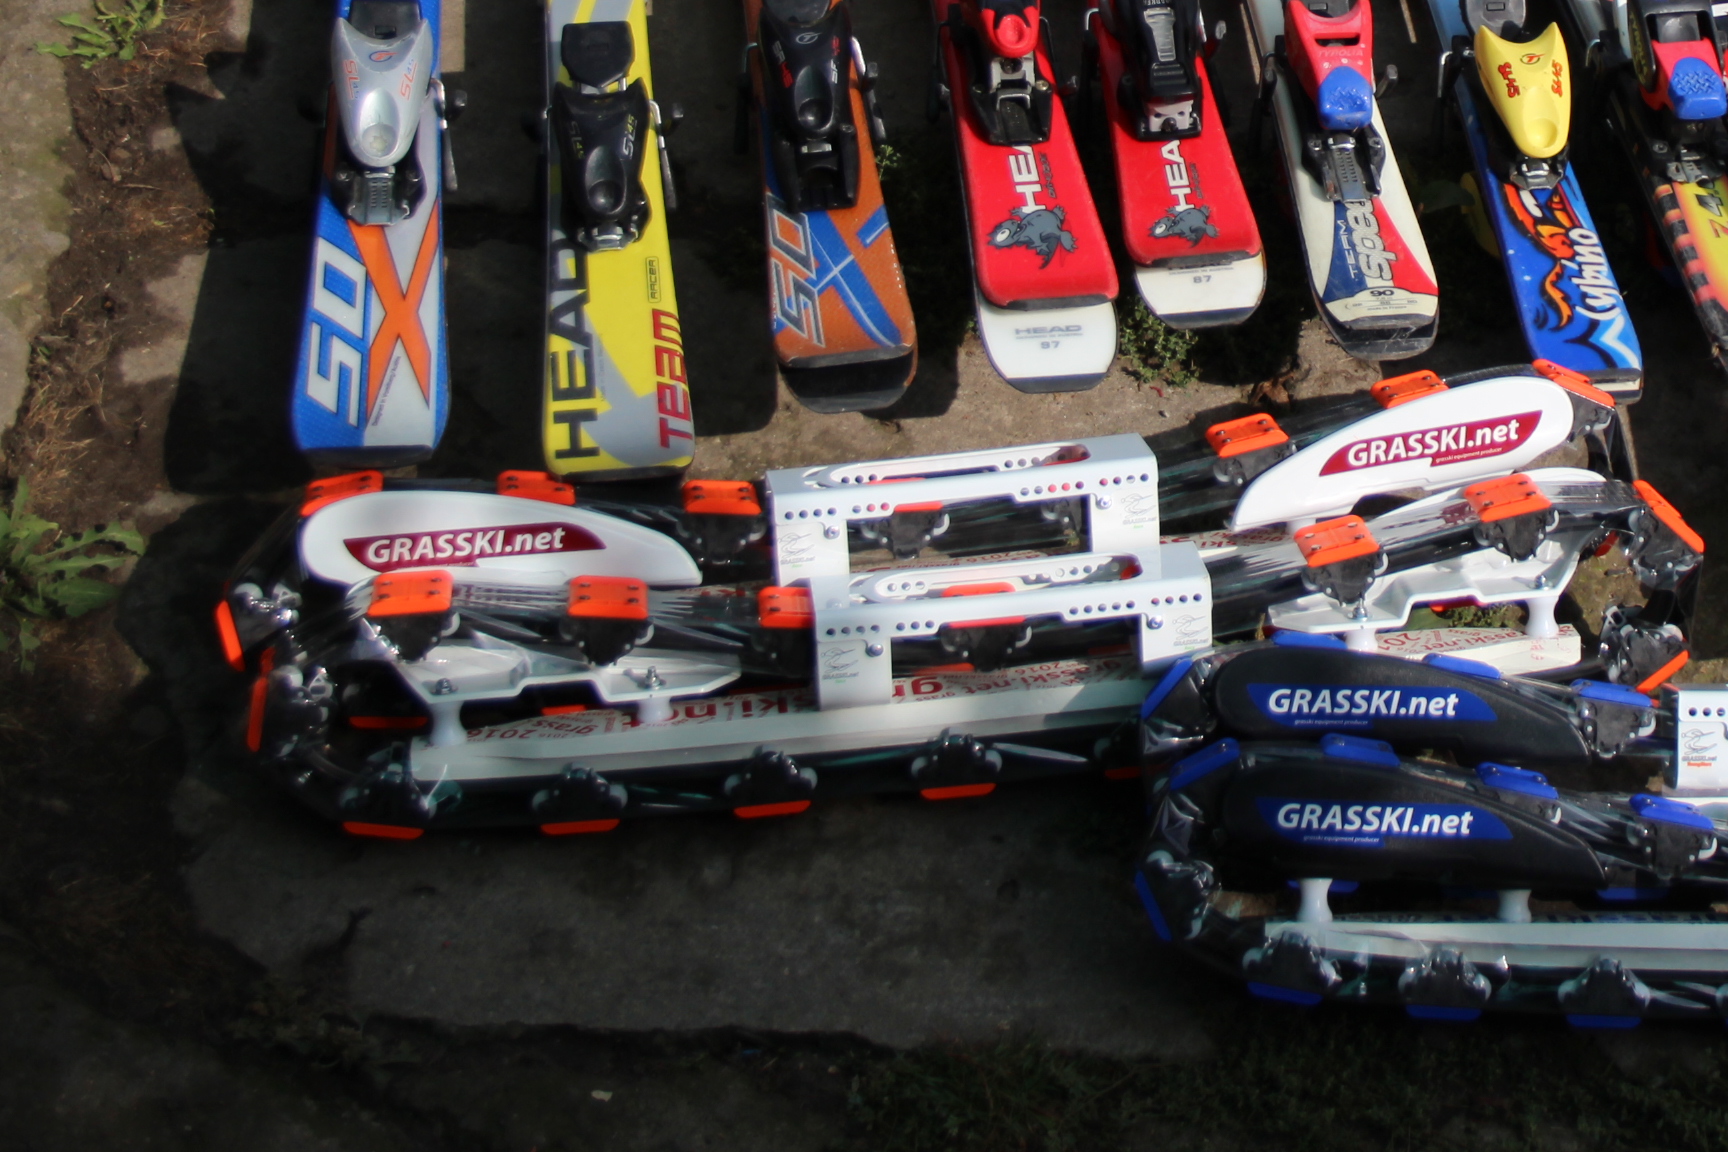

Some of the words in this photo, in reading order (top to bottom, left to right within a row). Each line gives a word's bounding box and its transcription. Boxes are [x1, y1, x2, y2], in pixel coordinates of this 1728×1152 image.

[1161, 139, 1195, 213] HEA
[1337, 219, 1358, 279] TEAM
[1370, 289, 1394, 297] 90
[549, 232, 600, 460] HEAD
[1014, 324, 1083, 336] HEAD
[1347, 419, 1520, 466] GRASSKI.net
[367, 527, 566, 564] GRASSKI.net
[1268, 688, 1459, 716] GRASSKI.net
[539, 717, 597, 736] grass
[1277, 803, 1474, 835] GRASSKI.net
